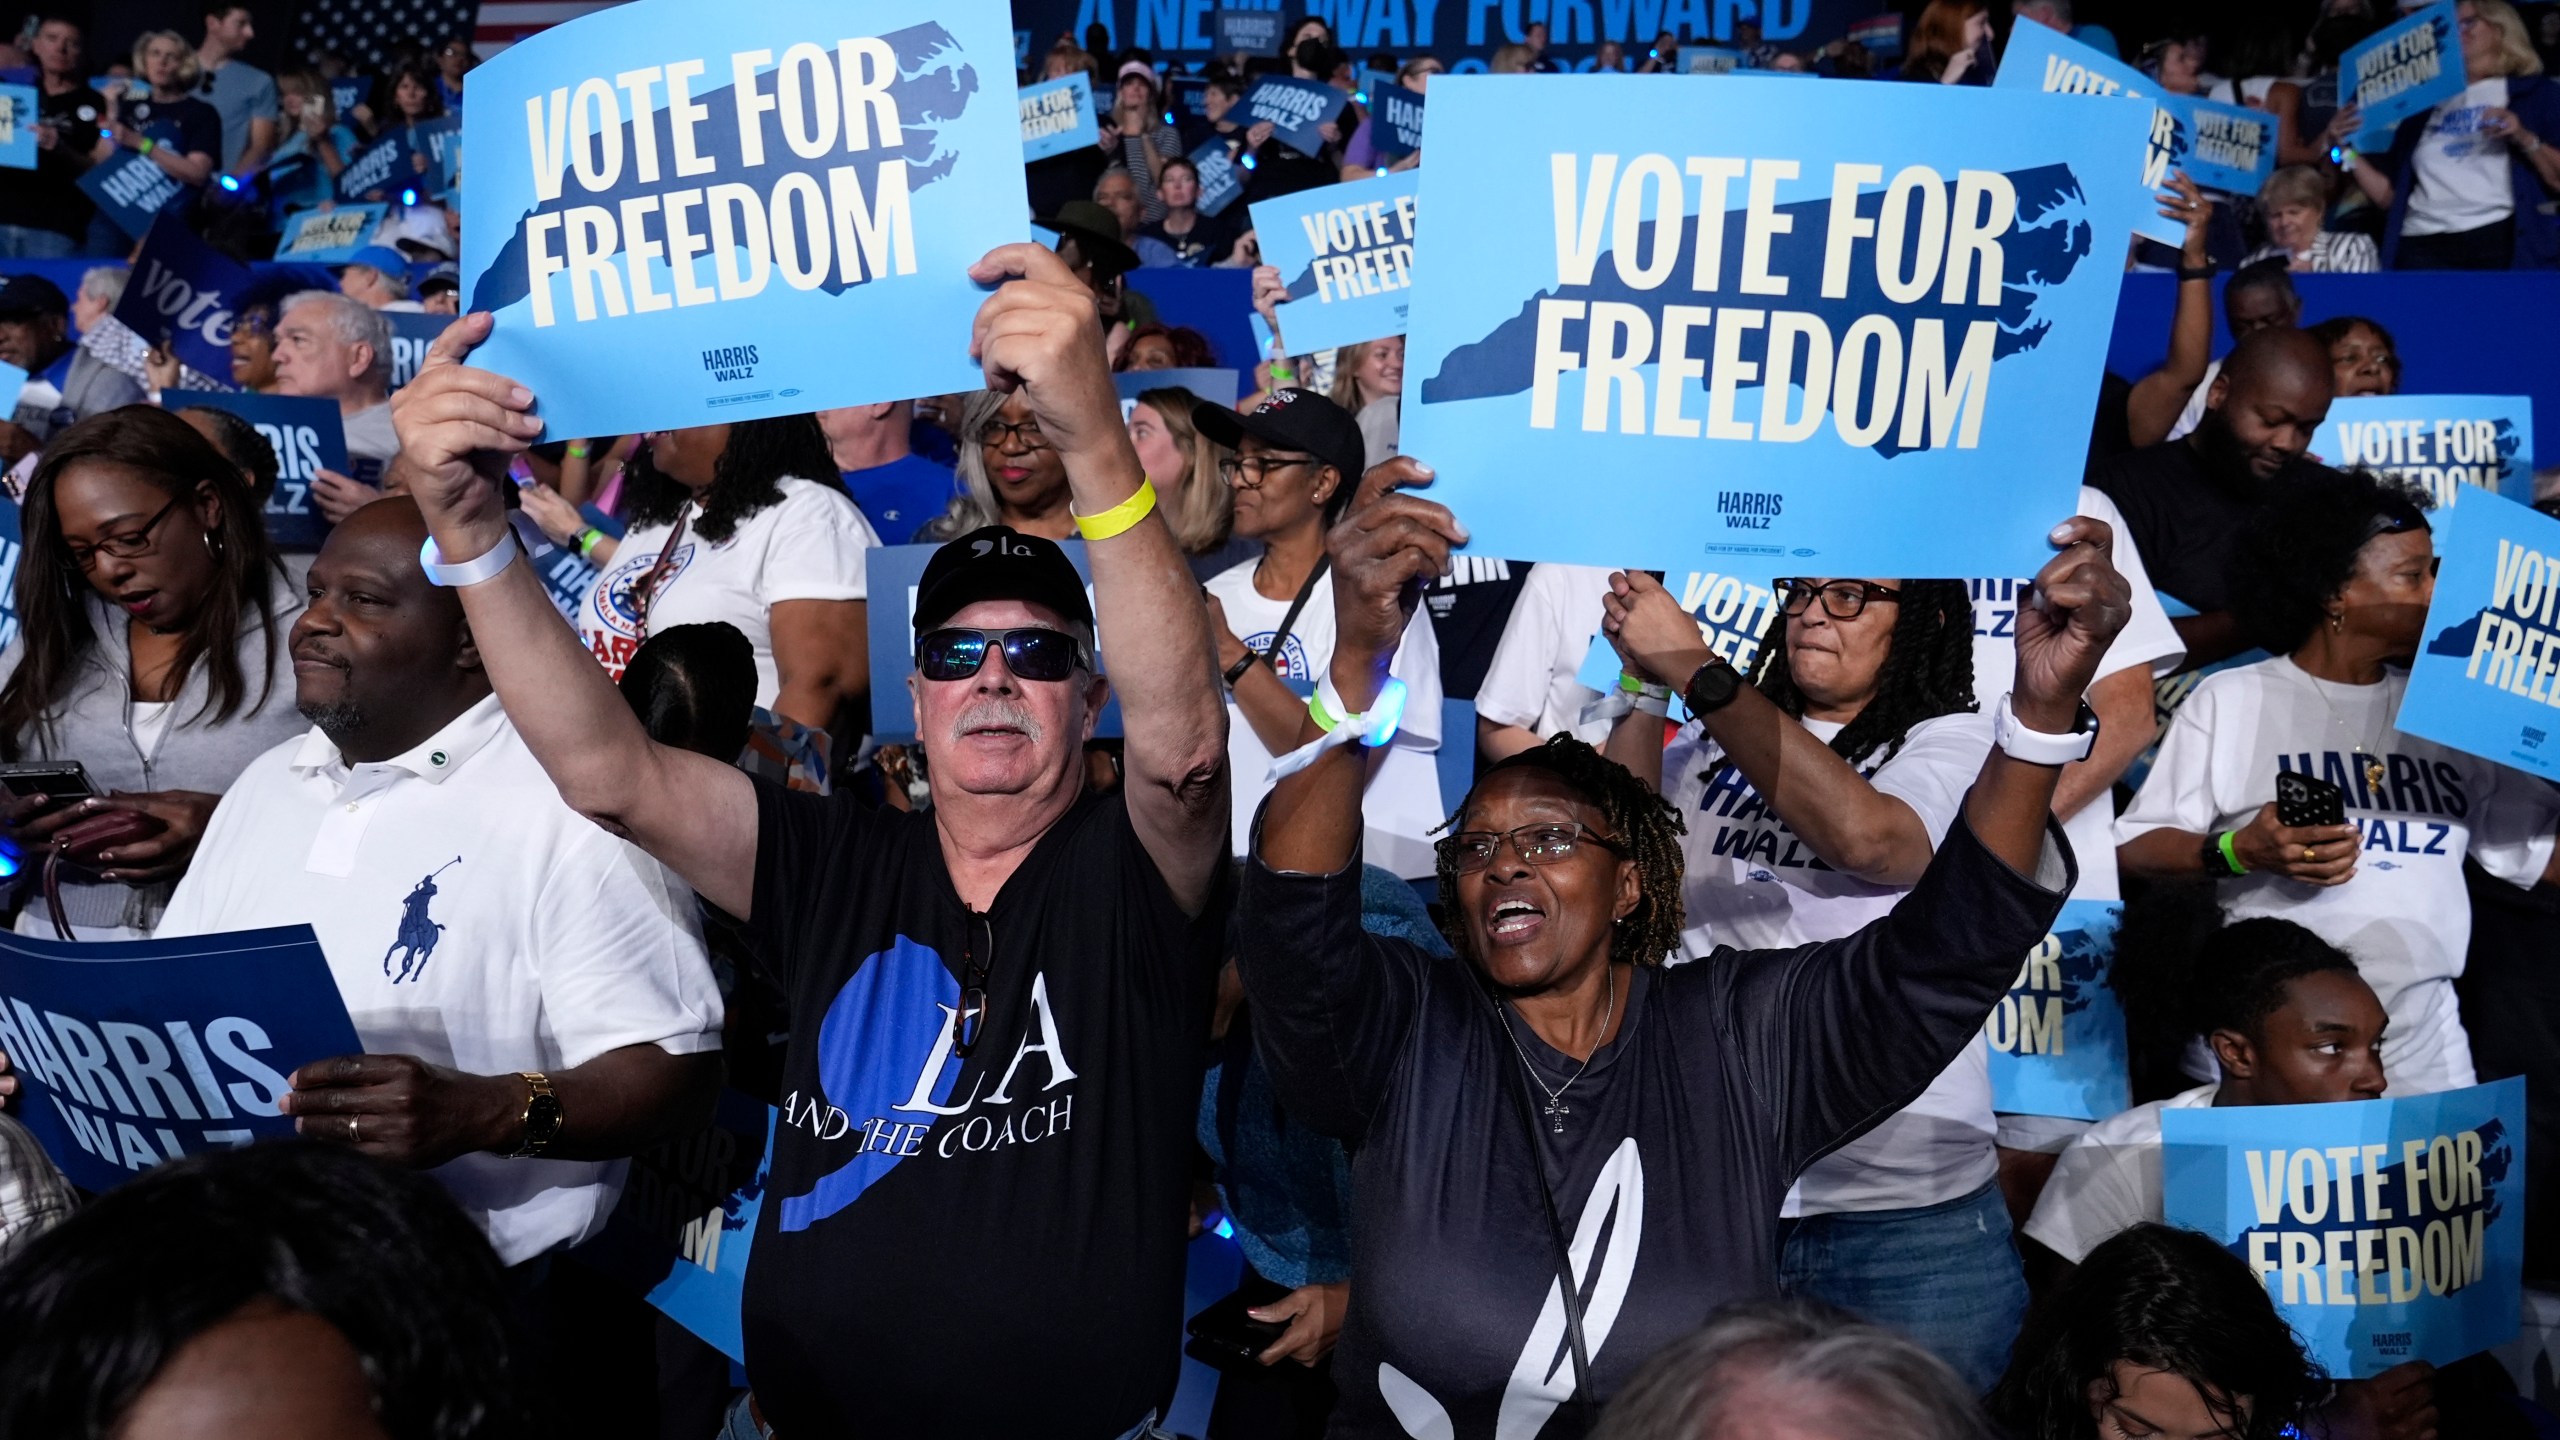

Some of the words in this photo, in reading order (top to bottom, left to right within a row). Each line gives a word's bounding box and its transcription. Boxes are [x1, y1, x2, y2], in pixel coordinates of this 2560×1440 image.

[2398, 22, 2437, 63] FOR
[526, 59, 716, 202] VOTE
[732, 37, 904, 167] FOR
[1042, 87, 1074, 117] FOR
[1250, 83, 1328, 122] HARRIS
[1250, 104, 1304, 132] WALZ
[526, 159, 918, 328] FREEDOM
[1301, 201, 1395, 257] VOTE
[1551, 153, 1800, 296] VOTE
[1821, 162, 2016, 307] FOR
[1312, 243, 1414, 304] FREED
[702, 345, 759, 371] HARRIS
[715, 367, 754, 382] WALZ
[1530, 298, 1998, 449] FREEDOM
[2337, 420, 2428, 467] VOTE
[2434, 419, 2498, 465] FOR
[1717, 492, 1783, 516] HARRIS
[1726, 515, 1771, 529] WALZ
[891, 970, 1078, 1116] LA
[784, 1089, 851, 1141] AND
[856, 1117, 930, 1158] THE
[938, 1094, 1073, 1159] COACH
[2245, 1143, 2393, 1225] VOTE
[2402, 1130, 2484, 1217] FOR
[2248, 1209, 2484, 1306] FREEDOM
[2372, 1331, 2412, 1347] HARRIS
[2378, 1346, 2409, 1356] WALZ
